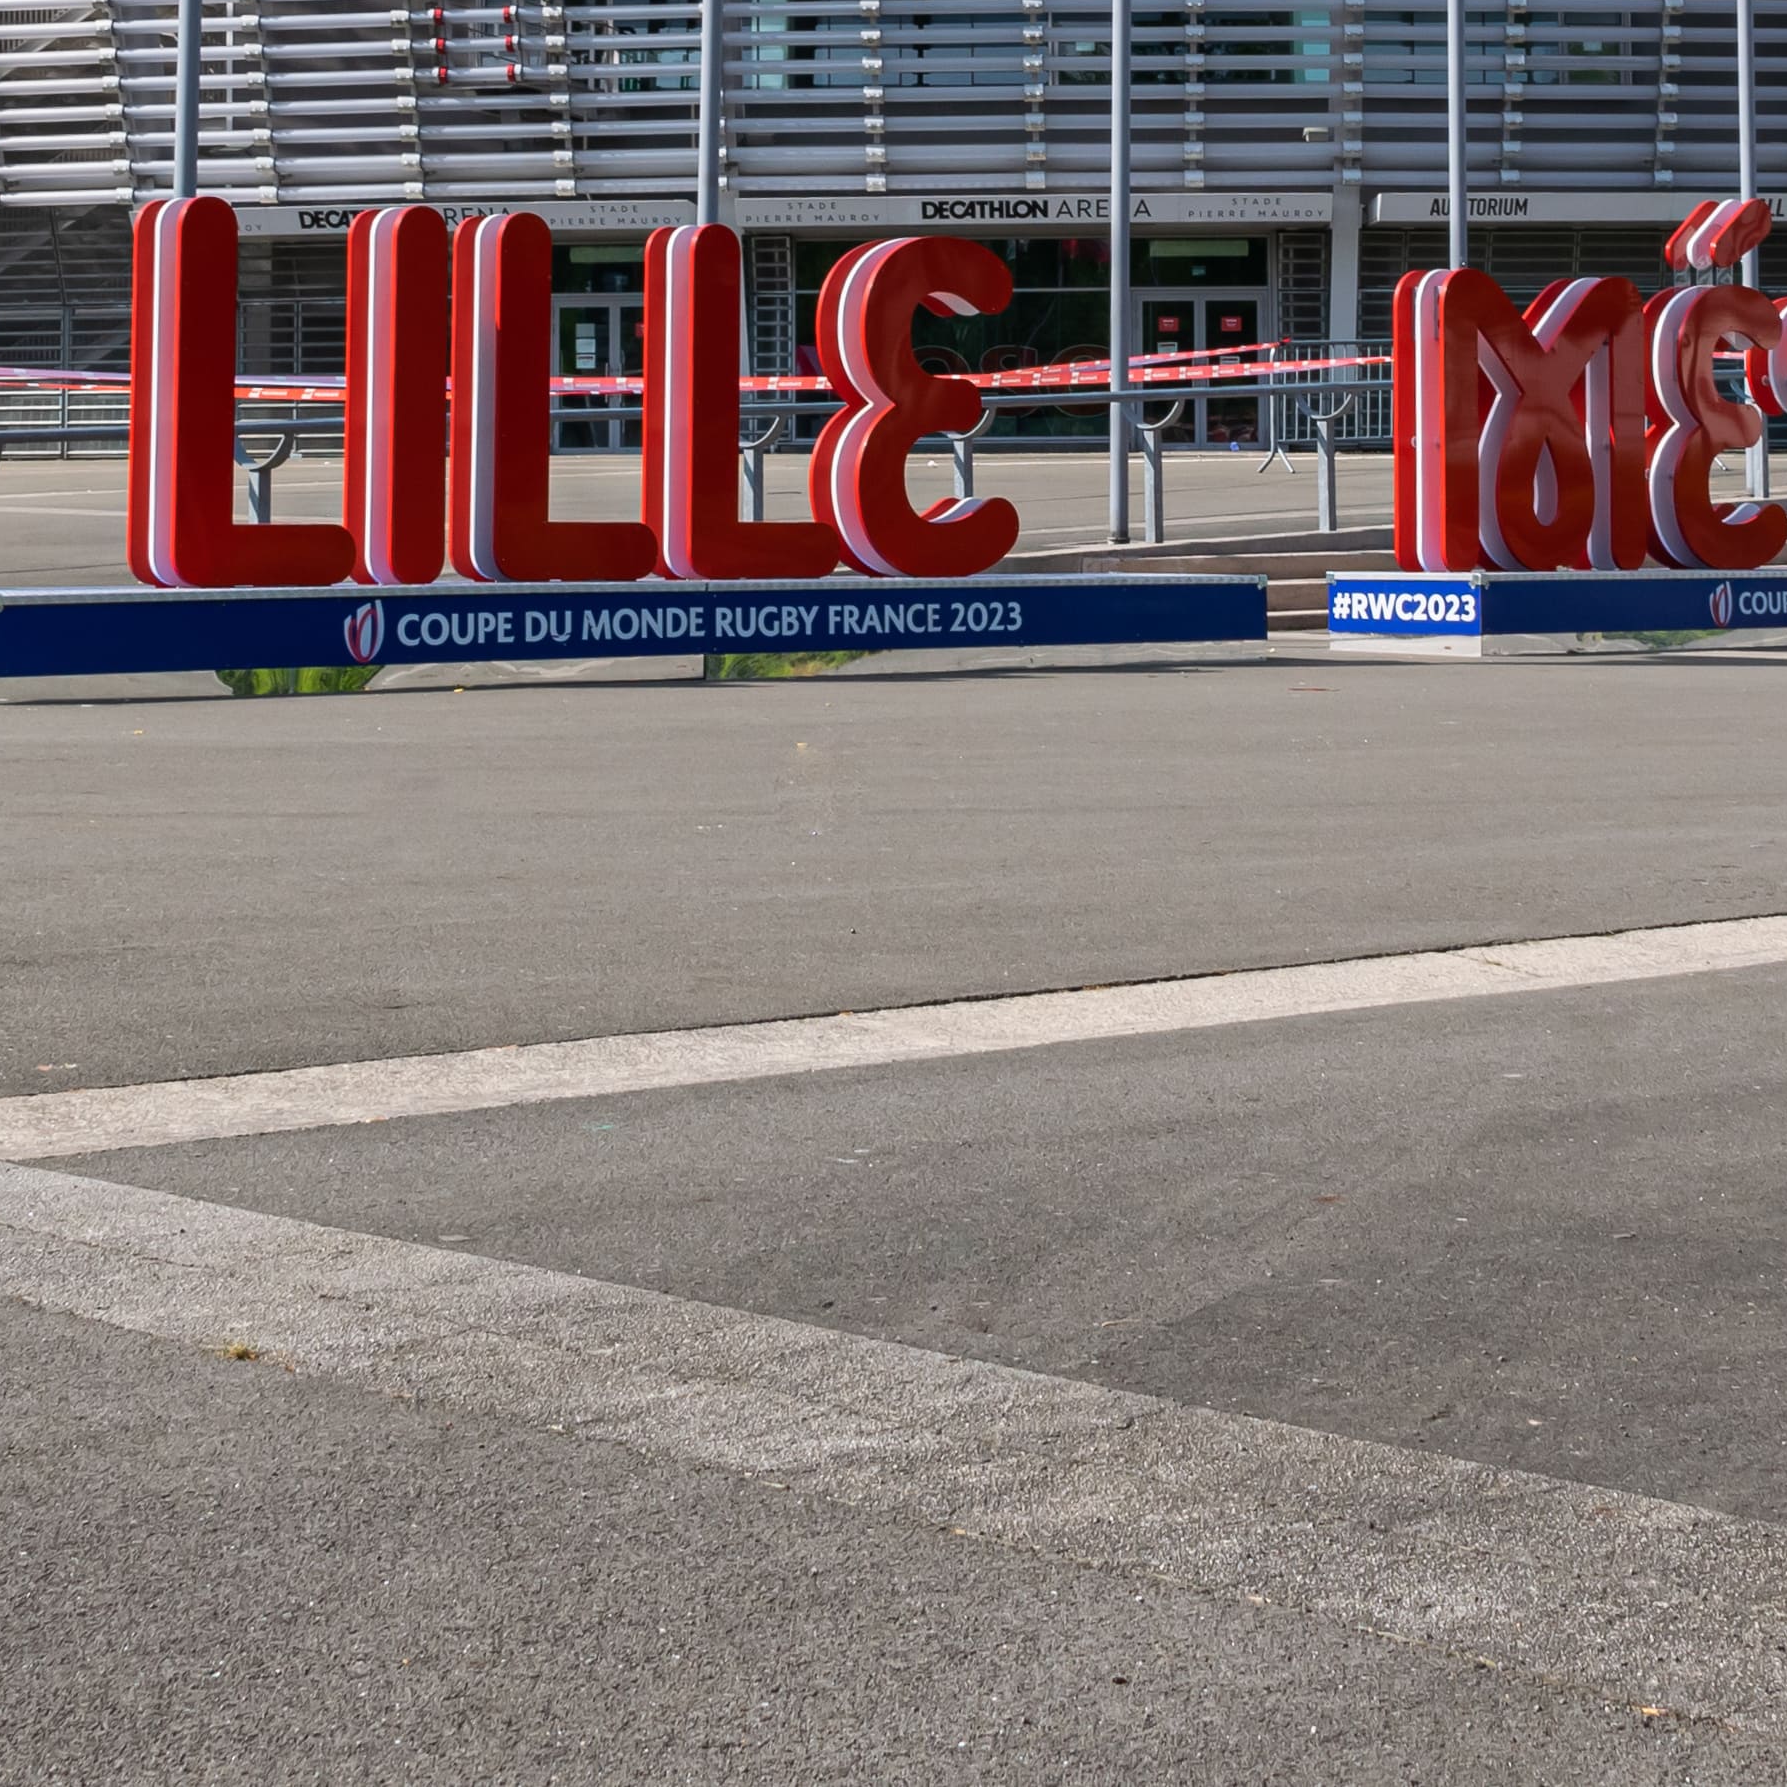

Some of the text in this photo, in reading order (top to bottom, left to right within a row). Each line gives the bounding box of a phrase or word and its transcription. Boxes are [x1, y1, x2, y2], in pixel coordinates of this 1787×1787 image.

[788, 202, 836, 210] STADE
[1232, 198, 1281, 206] STADE
[1430, 198, 1528, 215] AUTORIUM
[590, 205, 638, 213] STADE
[922, 199, 1151, 220] DECATHLON AREA
[1189, 209, 1324, 218] PIERRE MAUROY
[550, 217, 681, 225] PIERRE MAUROY
[746, 214, 879, 222] PIERRE MAUROY
[128, 196, 1019, 587] LILLE
[1332, 591, 1476, 622] #RWC2023
[397, 601, 1023, 647] COUPE DU MONDE RUGBY FRANCE 2023
